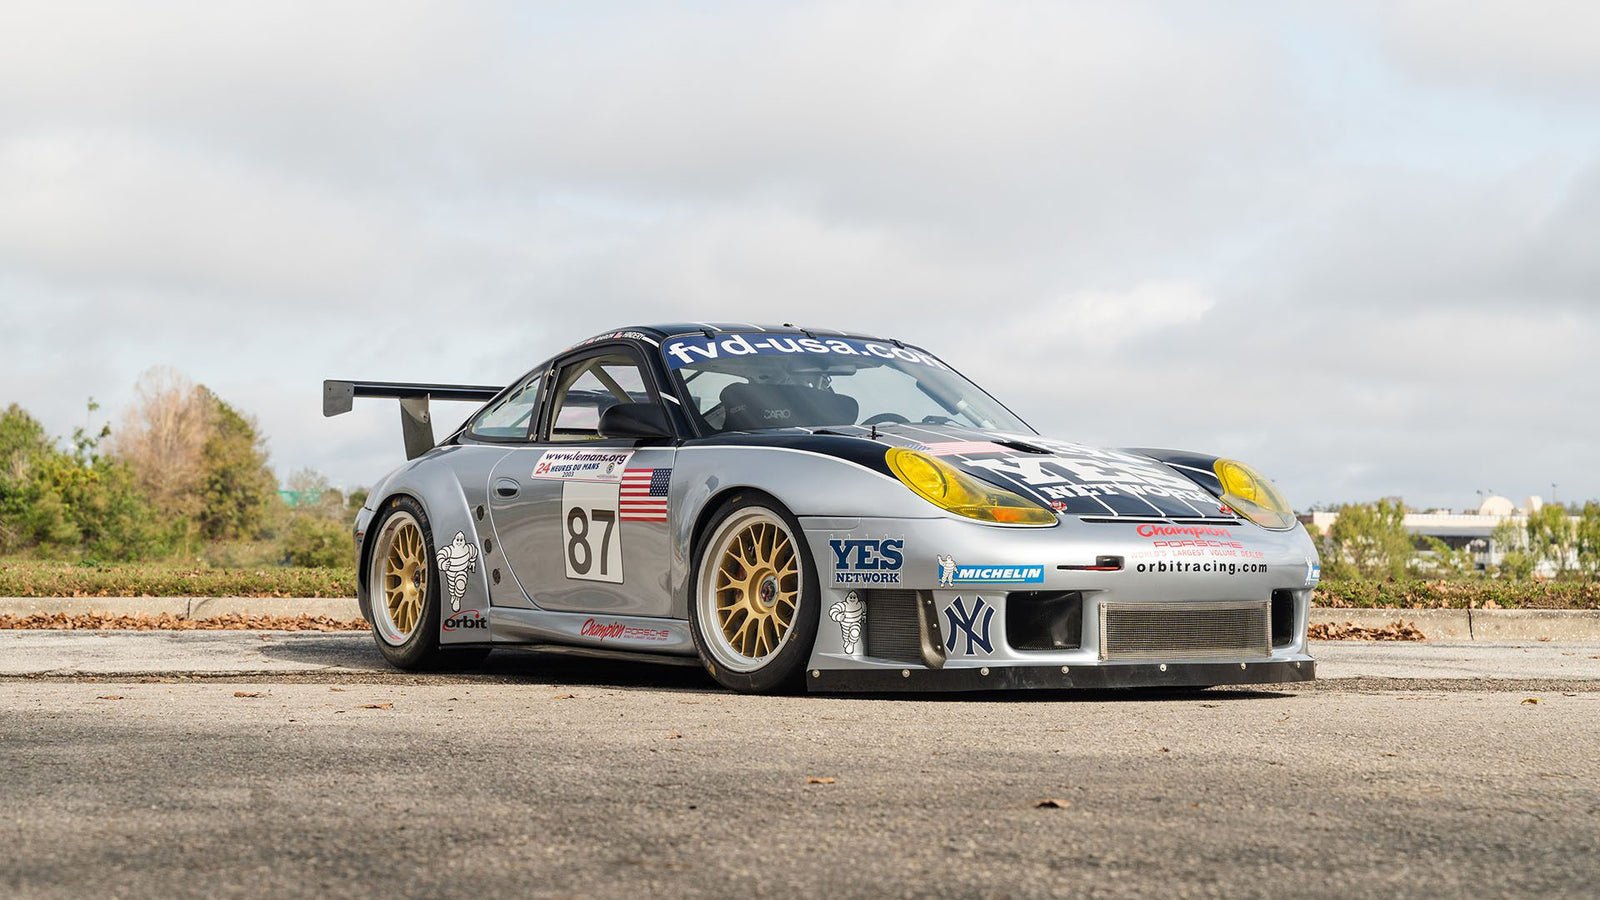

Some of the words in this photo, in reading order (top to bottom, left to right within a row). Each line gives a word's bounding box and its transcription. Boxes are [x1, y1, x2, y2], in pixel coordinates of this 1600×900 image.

[668, 334, 949, 371] fvd-usa.com
[545, 451, 628, 465] www.lemans.org
[535, 462, 552, 475] 24
[582, 462, 600, 470] MANS
[961, 457, 1200, 492] YES
[1136, 524, 1233, 539] Champion
[567, 507, 616, 576] 87
[1153, 539, 1243, 549] PORSCHE
[829, 539, 904, 570] YES
[1172, 549, 1206, 557] LARGEST
[1209, 549, 1237, 557] VOLUME
[958, 568, 1042, 579] MICHELIN
[1136, 560, 1268, 575] orbitracing.com
[835, 572, 900, 583] NETWORK
[444, 614, 488, 629] orbit
[580, 618, 626, 641] Champion
[624, 627, 670, 638] PORSCHE
